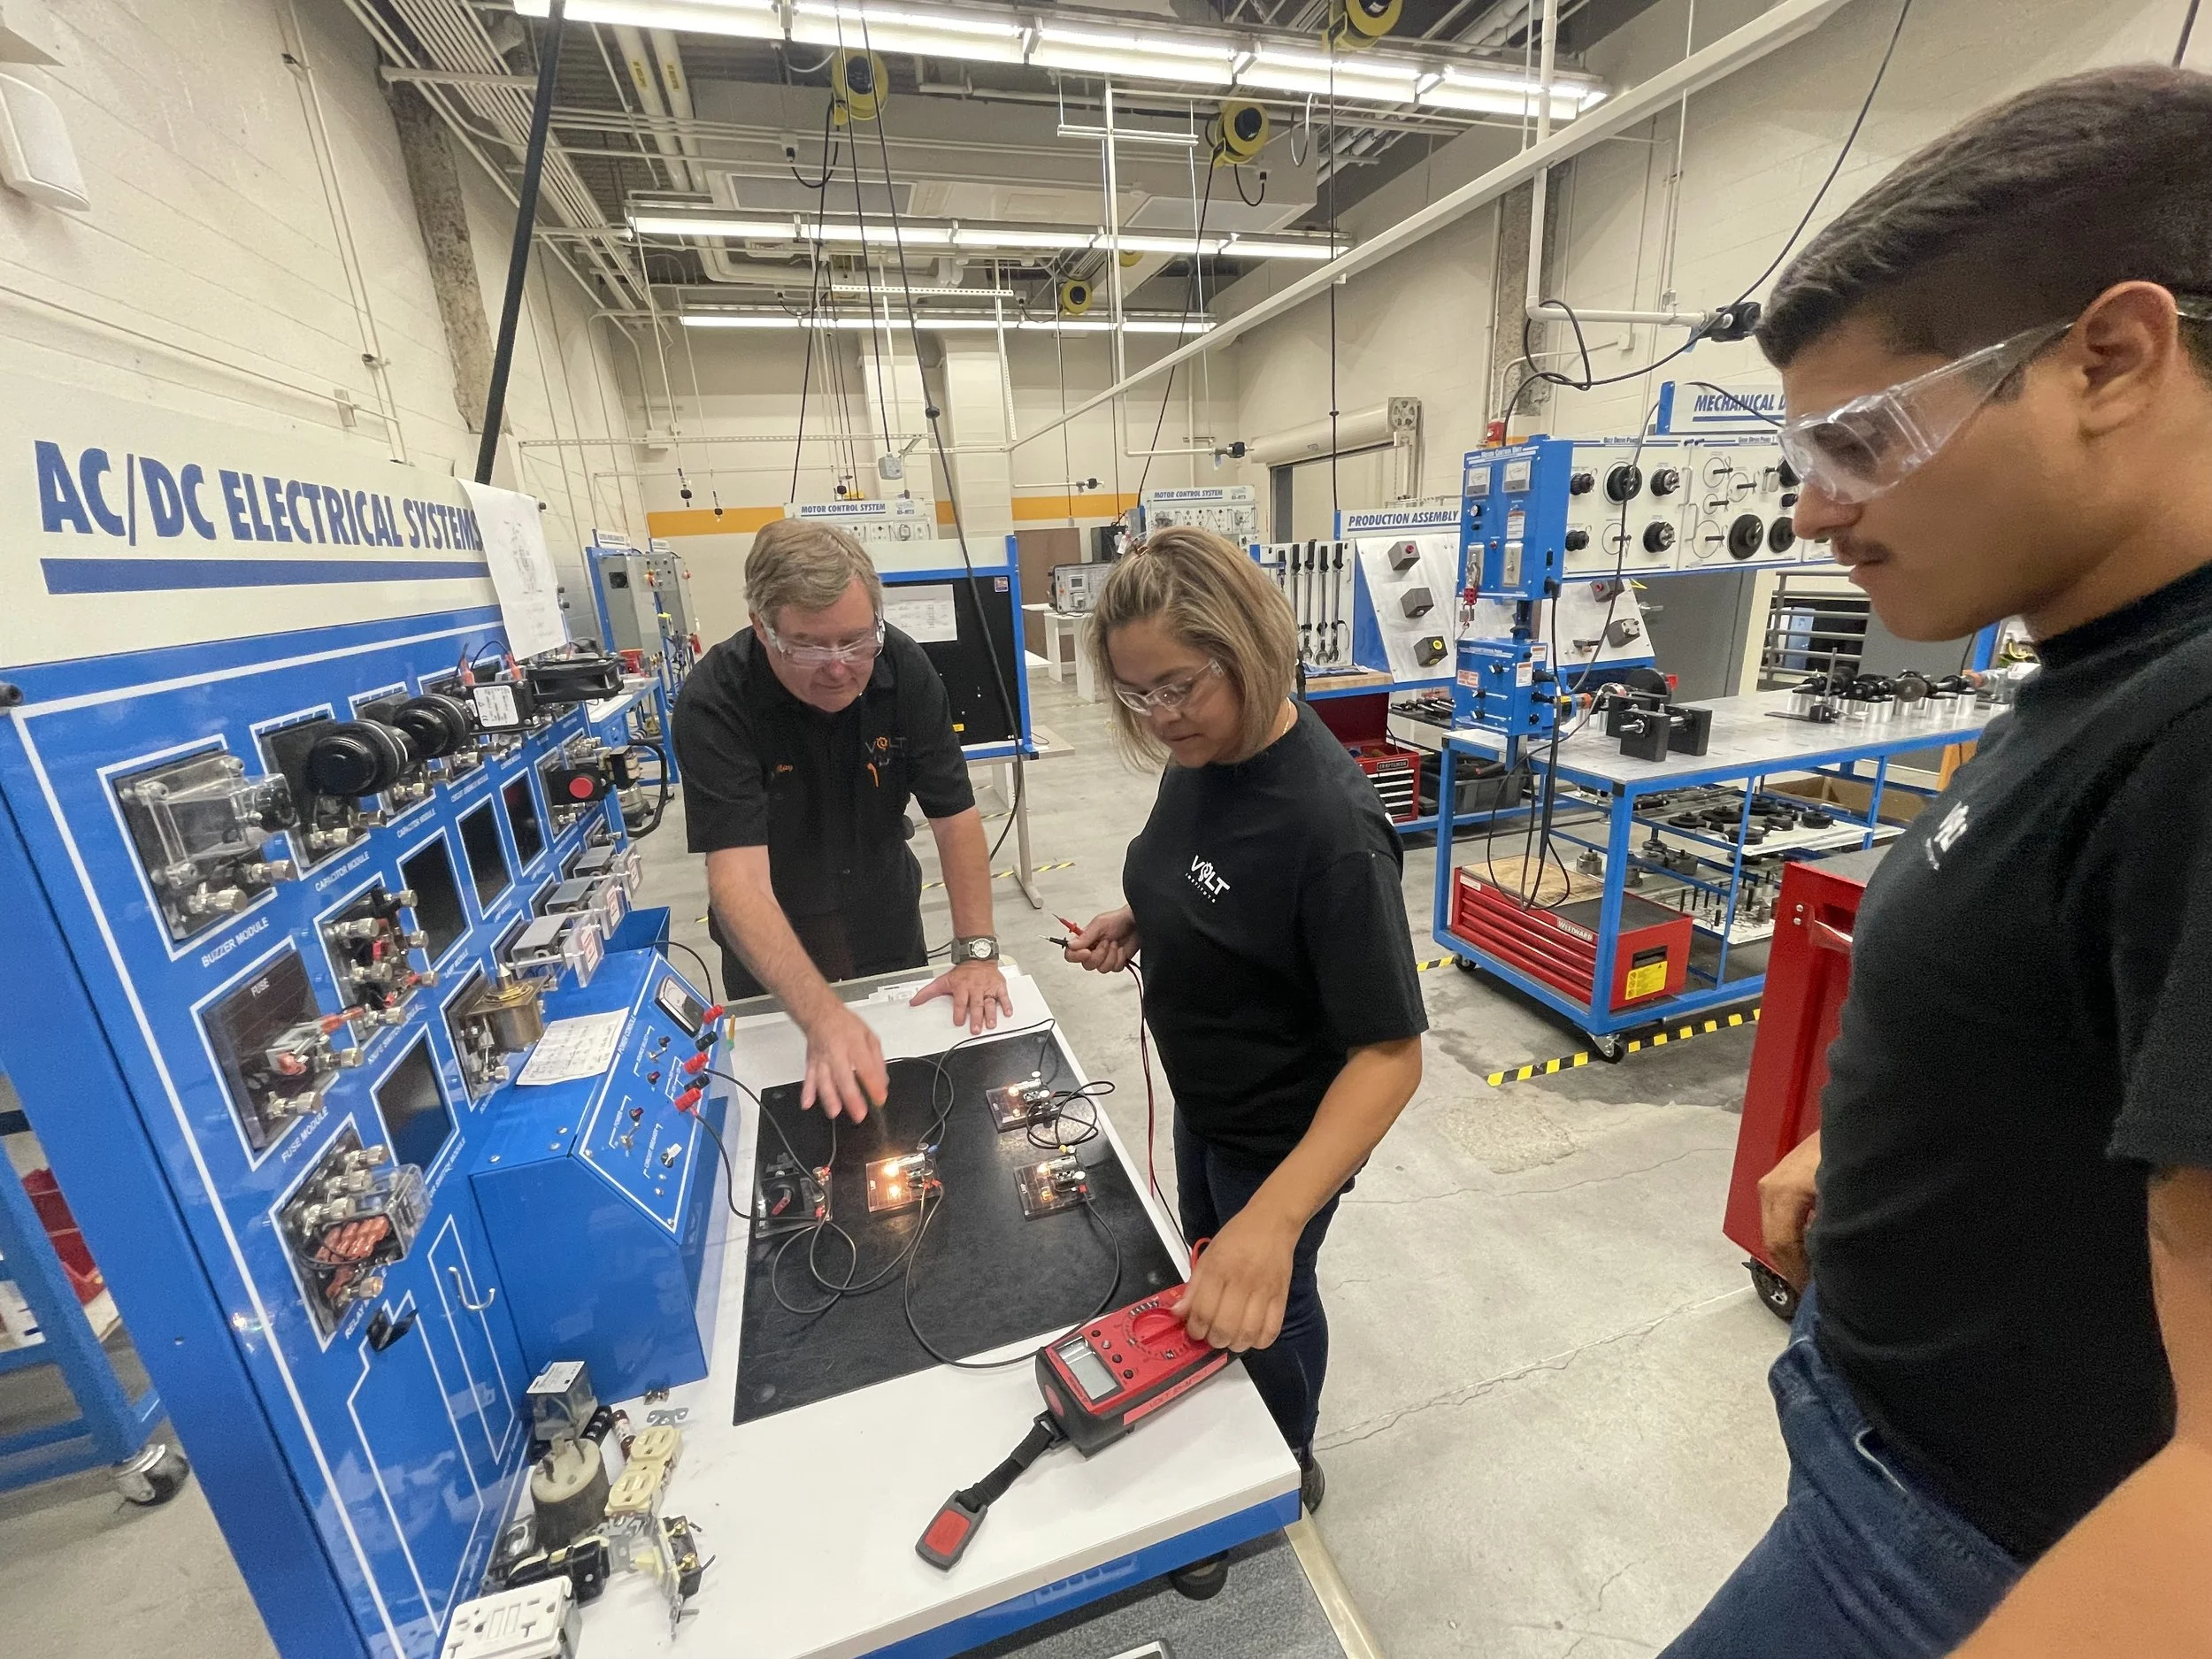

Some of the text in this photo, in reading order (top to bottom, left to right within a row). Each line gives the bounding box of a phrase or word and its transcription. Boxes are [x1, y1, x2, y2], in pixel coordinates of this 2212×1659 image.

[1694, 394, 1774, 412] MECHANICAL
[34, 440, 484, 552] AC/DC ELECTRICAL SYSTEMS
[801, 505, 826, 514] MOTOR
[828, 503, 858, 513] CONTROL
[859, 503, 886, 511] SYSTEM
[1348, 509, 1459, 527] PRODUCTION ASSEMBLY
[314, 850, 371, 892] CAPACITOR MODULE
[1190, 854, 1231, 895] VOLT
[201, 917, 270, 968] BUZZER MODULE
[1557, 919, 1594, 941] WESTWARD
[250, 977, 270, 998] FUSE
[281, 1104, 330, 1164] FUSE MODULE
[344, 1307, 365, 1340] RELAY
